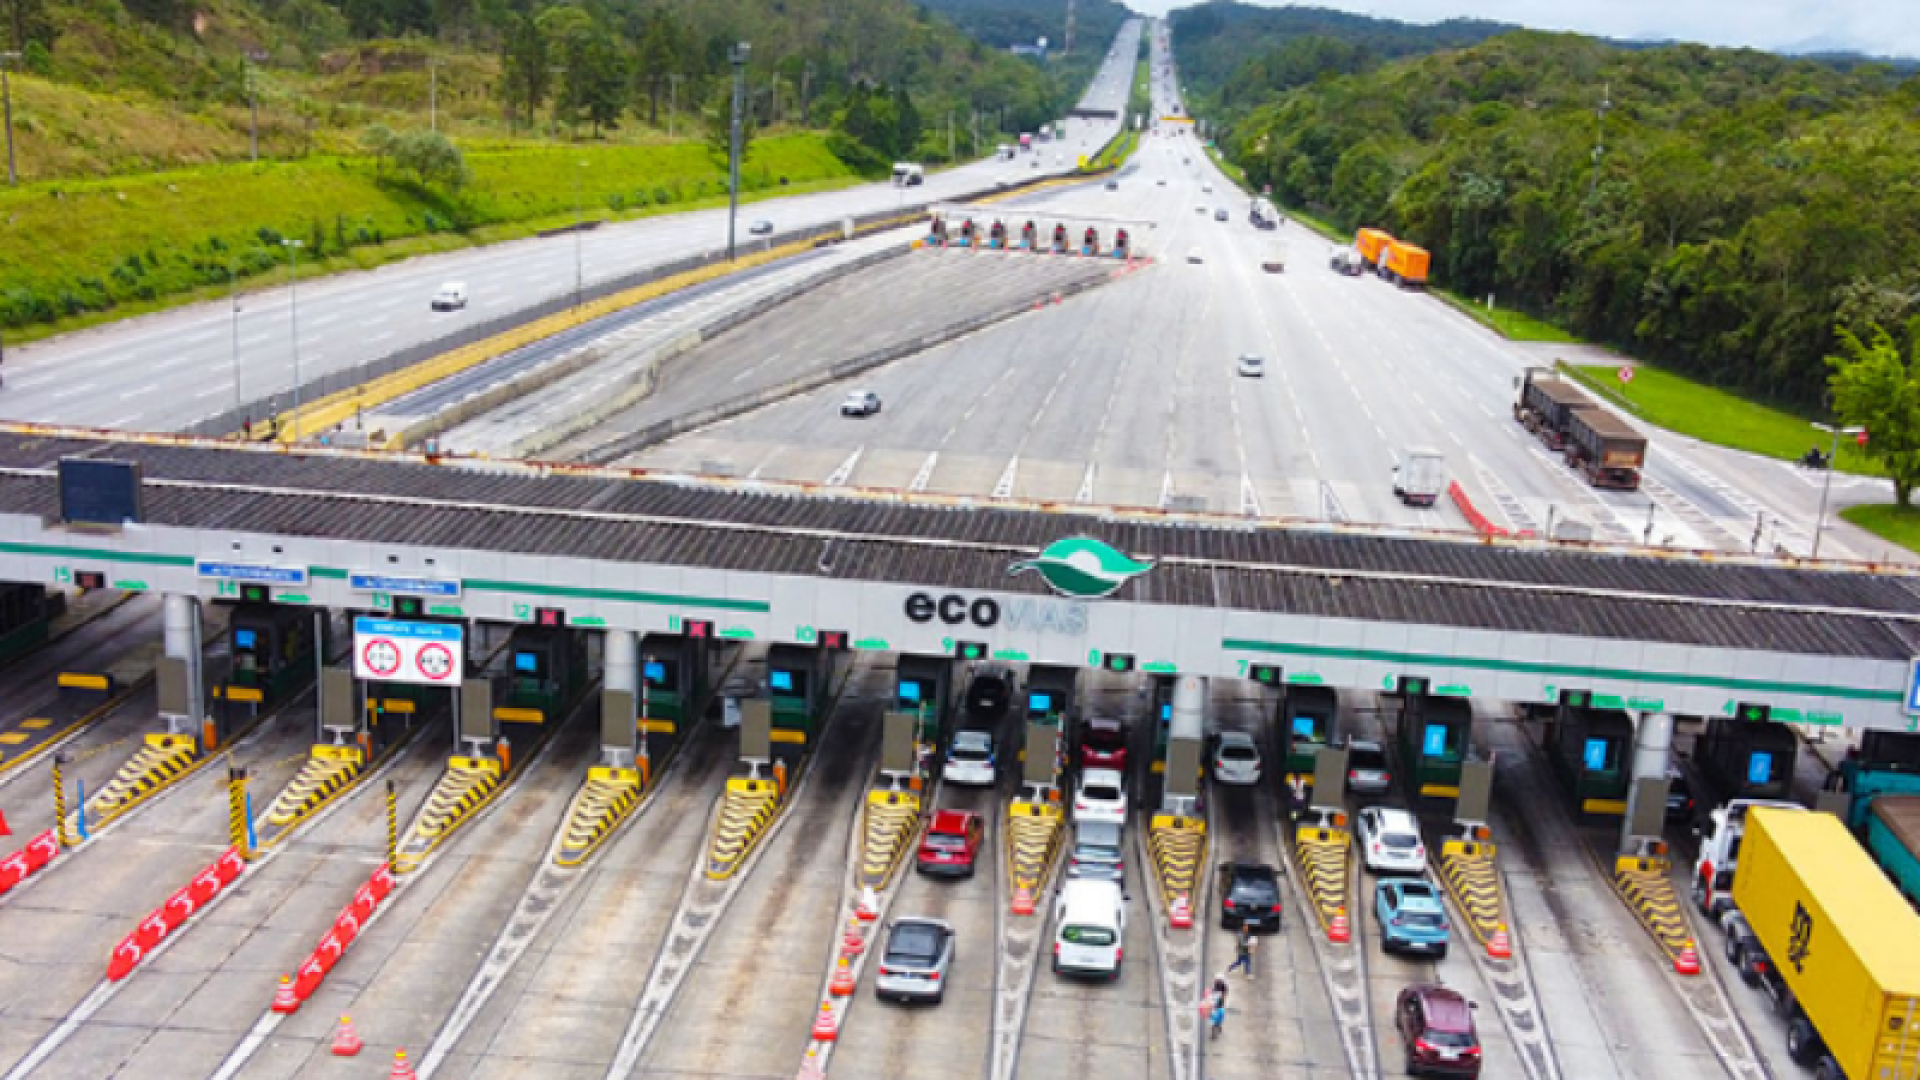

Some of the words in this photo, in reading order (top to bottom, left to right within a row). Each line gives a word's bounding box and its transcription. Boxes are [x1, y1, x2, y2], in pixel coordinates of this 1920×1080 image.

[53, 566, 71, 583] 15
[218, 580, 237, 596] 14
[513, 603, 530, 619] 12
[669, 614, 680, 631] 11
[795, 625, 816, 642] 10
[941, 636, 955, 653] 9
[1236, 660, 1248, 678] 7
[1382, 672, 1395, 689] 6
[1544, 684, 1557, 703] 5
[1723, 699, 1736, 716] 4
